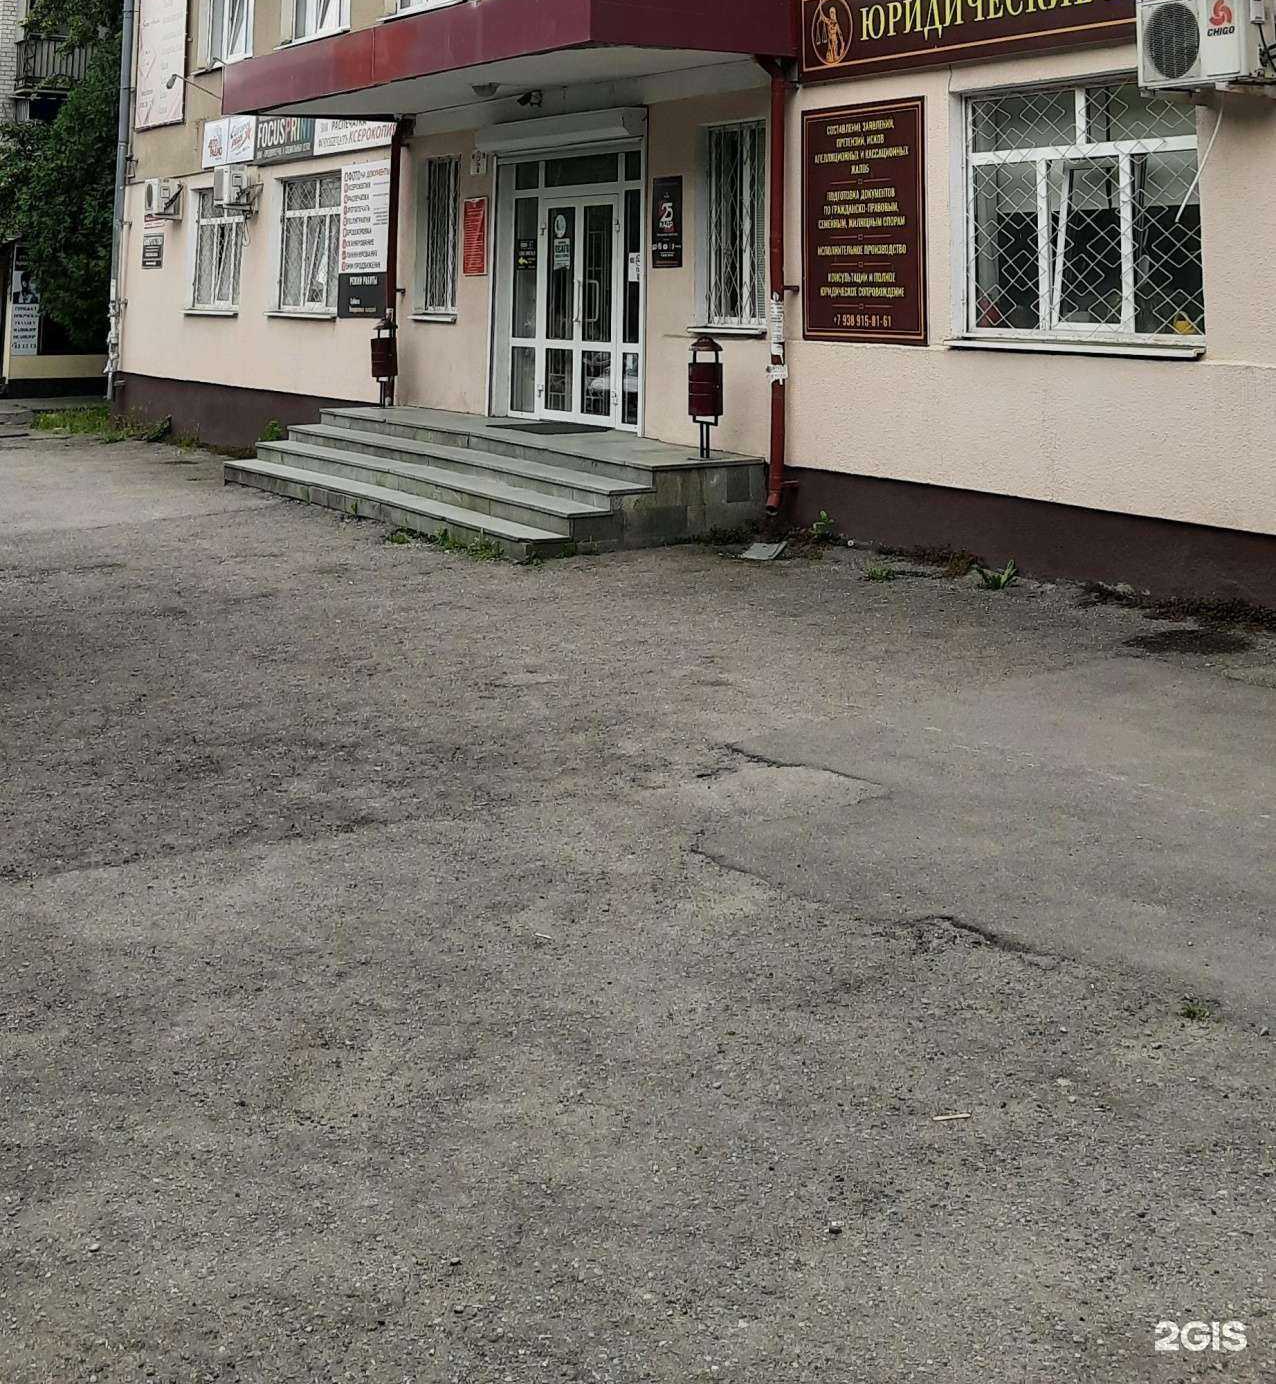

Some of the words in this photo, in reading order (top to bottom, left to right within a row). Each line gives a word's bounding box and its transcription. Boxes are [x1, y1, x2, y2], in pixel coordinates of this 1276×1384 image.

[1207, 26, 1235, 37] CHIGO
[256, 118, 313, 148] FOCUSPRINT
[866, 133, 885, 145] ИСКОВ
[860, 187, 895, 200] ДОКУМЕНТОВ
[883, 216, 906, 226] СПОРАМ
[864, 243, 907, 256] ПРОИЗВОДСТВО
[873, 272, 896, 282] ПОЛНОЕ
[858, 287, 905, 299] СОПРОВОЖДЕНИЕ
[833, 314, 840, 326] +7
[842, 314, 855, 327] 938
